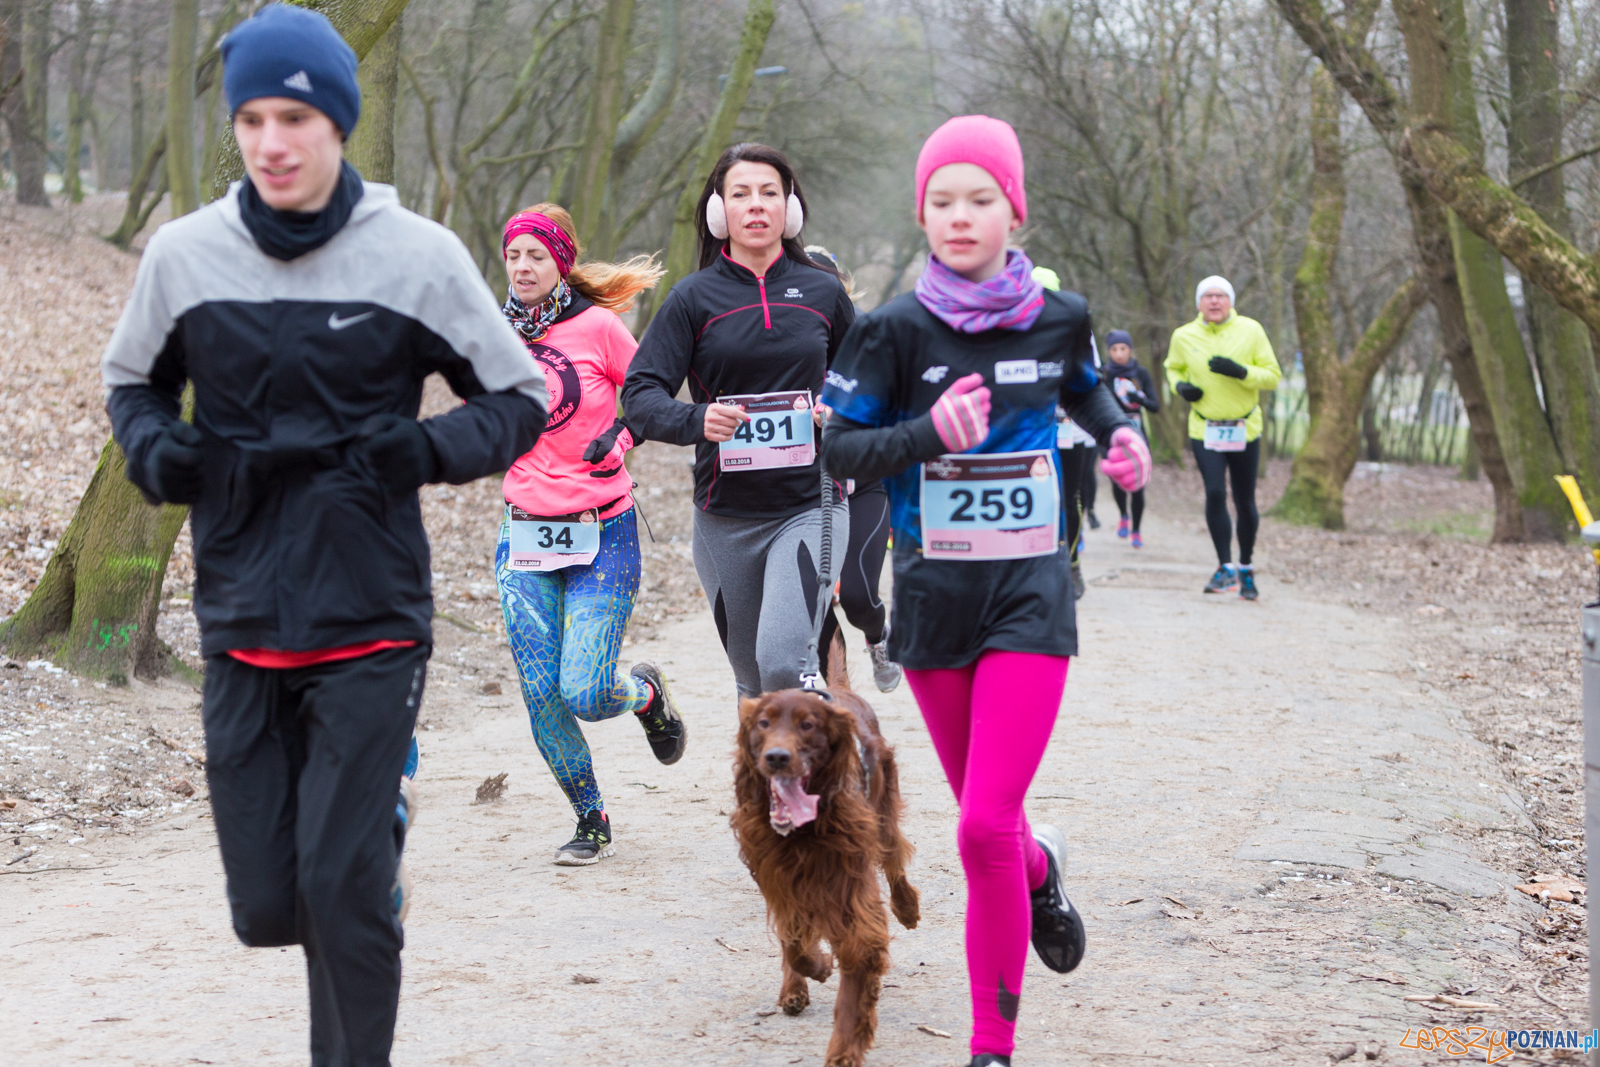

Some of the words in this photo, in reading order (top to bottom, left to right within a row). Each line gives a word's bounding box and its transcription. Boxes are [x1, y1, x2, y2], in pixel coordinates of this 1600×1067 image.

[540, 349, 568, 372] żeby
[921, 365, 949, 384] 4F
[734, 415, 793, 443] 491
[1218, 428, 1234, 439] 77
[949, 487, 1033, 522] 259
[537, 526, 574, 549] 34
